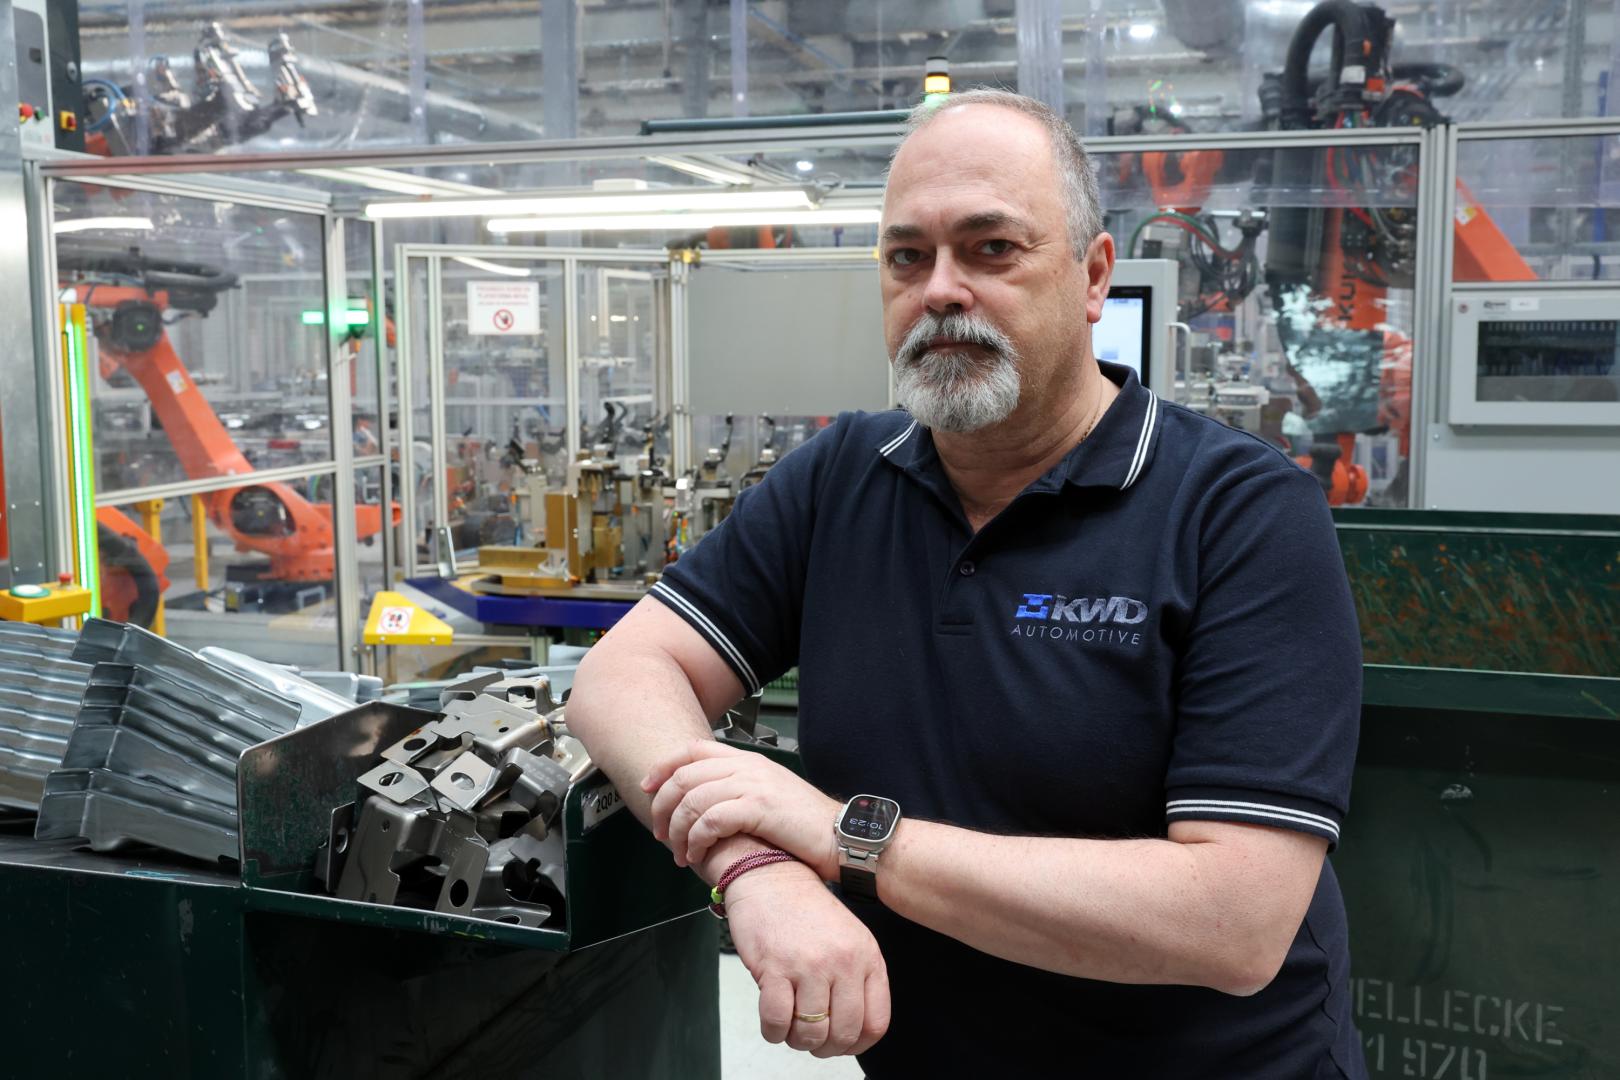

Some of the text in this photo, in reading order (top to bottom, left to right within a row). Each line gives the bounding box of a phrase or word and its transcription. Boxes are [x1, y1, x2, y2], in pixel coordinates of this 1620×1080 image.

[1051, 594, 1149, 625] KWD
[1010, 624, 1141, 645] AUTOMOTIVE
[849, 817, 884, 831] 10:23
[1350, 978, 1565, 1046] ELLECKE
